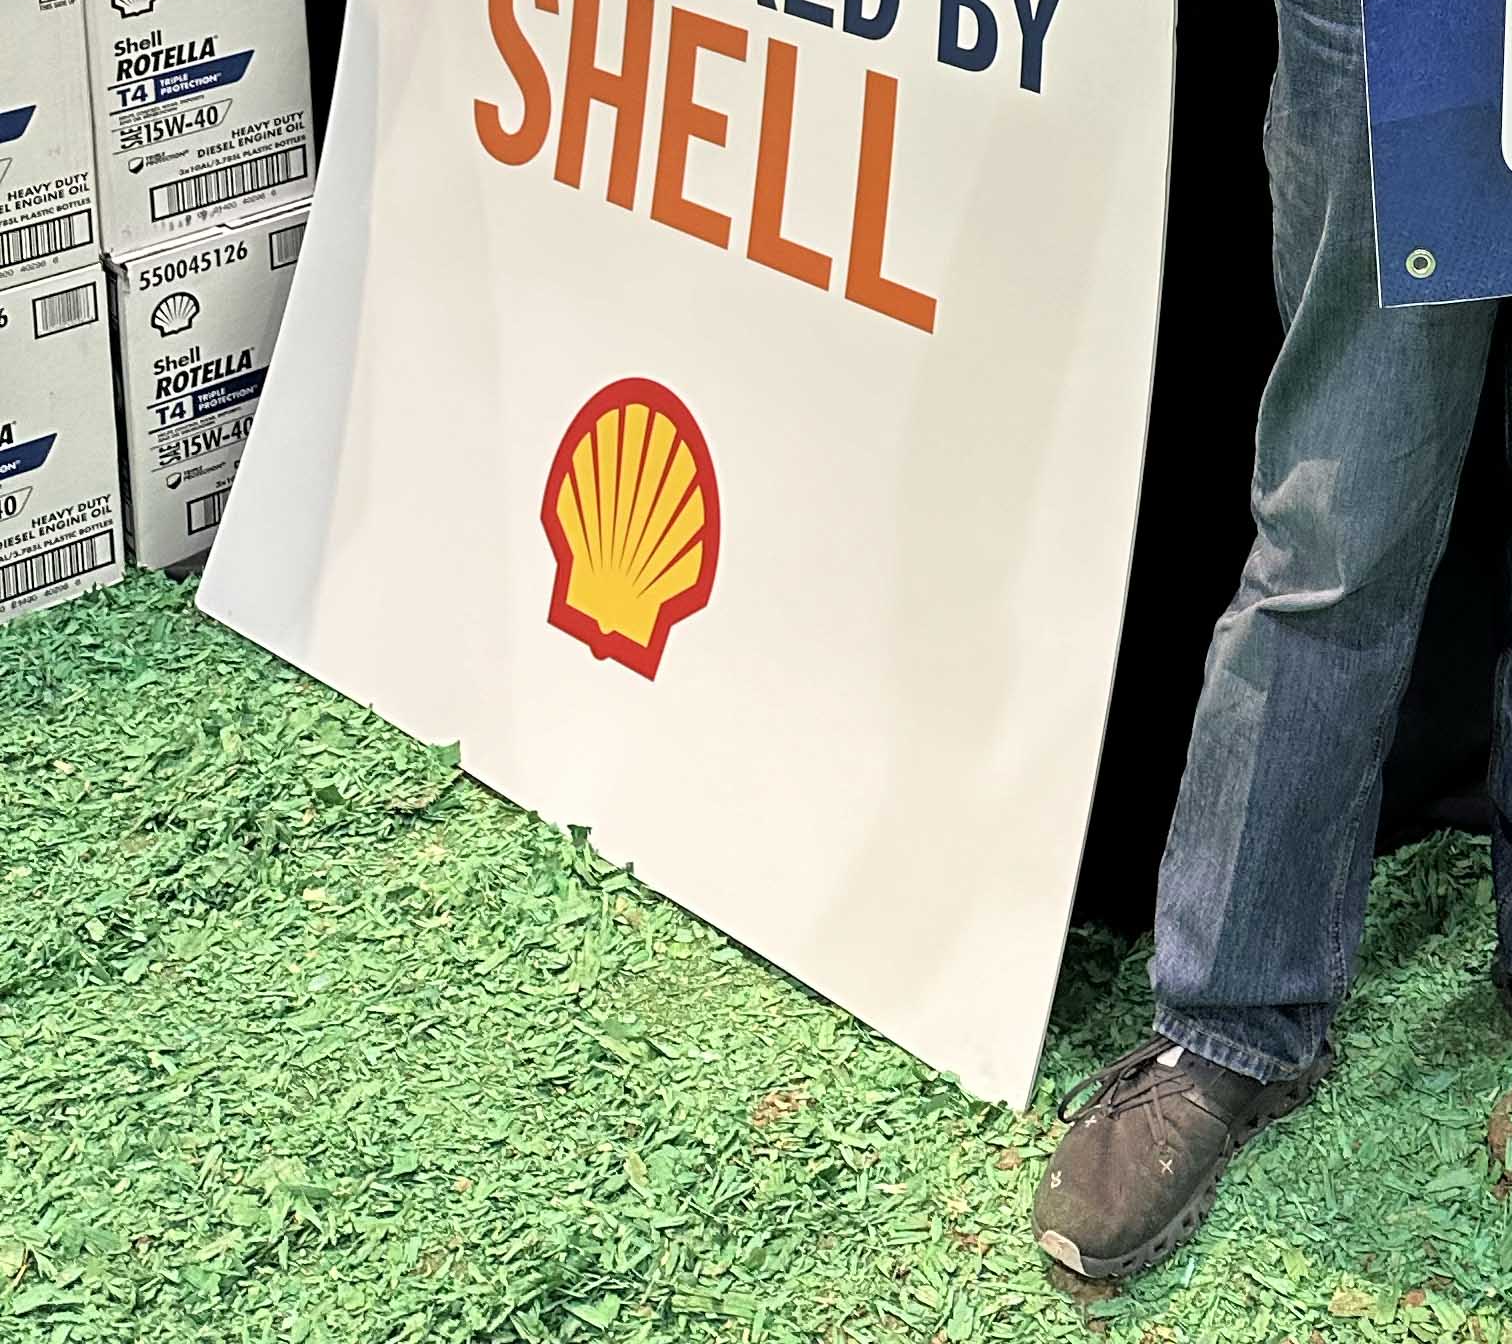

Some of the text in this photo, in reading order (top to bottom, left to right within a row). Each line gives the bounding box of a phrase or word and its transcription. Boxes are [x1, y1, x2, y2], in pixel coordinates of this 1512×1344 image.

[114, 30, 162, 57] Shell
[116, 36, 218, 83] ROTELLA
[160, 73, 188, 87] TRIPLE
[117, 84, 148, 109] T4
[145, 105, 218, 145] 15W-40
[231, 111, 304, 139] HEAVY DUTY
[197, 122, 305, 159] DIESEL ENGINE OIL
[8, 172, 89, 202] HEAVY DUTY
[14, 183, 90, 209] ENGINE OIL
[19, 206, 54, 224] PLASTIC
[139, 241, 248, 291] 550045126
[153, 346, 200, 376] Shell
[155, 348, 254, 400] ROTELLA
[197, 387, 226, 402] TRIPLE
[157, 400, 187, 427] T4
[182, 416, 253, 460] 15W-40
[31, 493, 111, 529] HEAVY DUTY
[38, 504, 113, 538] ENGINE OIL
